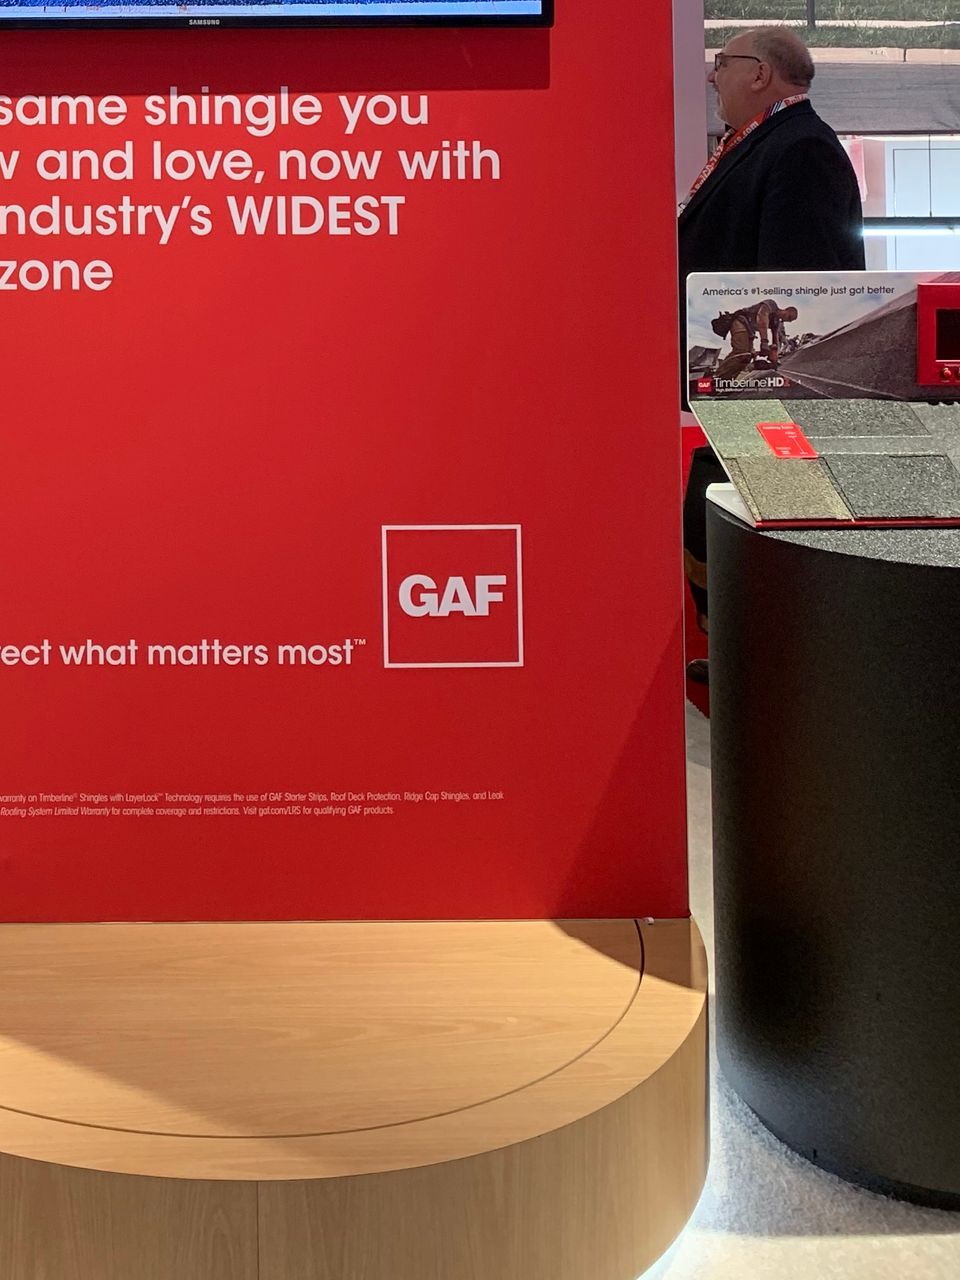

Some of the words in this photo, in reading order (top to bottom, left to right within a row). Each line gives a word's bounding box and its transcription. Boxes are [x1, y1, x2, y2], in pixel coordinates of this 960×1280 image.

[144, 86, 322, 137] shingle
[338, 94, 429, 134] you
[36, 141, 134, 180] and
[153, 141, 265, 184] love,
[279, 149, 382, 180] now
[398, 140, 500, 180] with
[226, 195, 406, 236] WIDEST
[702, 287, 749, 296] America's
[795, 286, 828, 297] shingle
[830, 286, 847, 297] just
[849, 286, 865, 297] got
[867, 285, 895, 294] better
[398, 574, 507, 618] GAF
[58, 639, 139, 665] what
[148, 639, 269, 665] matters
[0, 807, 27, 818] Roofing
[27, 807, 53, 817] System
[54, 807, 79, 816] Limited
[80, 807, 111, 816] Warranty
[111, 807, 121, 815] for
[122, 807, 154, 817] complete
[155, 807, 187, 817] coverage
[188, 807, 202, 815] and
[242, 806, 257, 815] Visit
[302, 806, 312, 814] for
[313, 805, 346, 816] qualifying
[347, 805, 361, 815] GAF
[27, 795, 38, 803] on
[79, 793, 108, 803] Shingles
[110, 793, 124, 802] with
[165, 793, 203, 803] Technology
[205, 793, 232, 803] requires
[233, 793, 245, 802] the
[246, 794, 259, 802] use
[260, 793, 268, 802] of
[269, 793, 283, 802] GAF
[284, 792, 307, 801] Starter
[330, 792, 346, 801] Roof
[347, 792, 365, 801] Deck
[403, 792, 423, 802] Ridge
[425, 792, 439, 802] Cap
[472, 791, 487, 800] and
[488, 791, 504, 800] Leak
